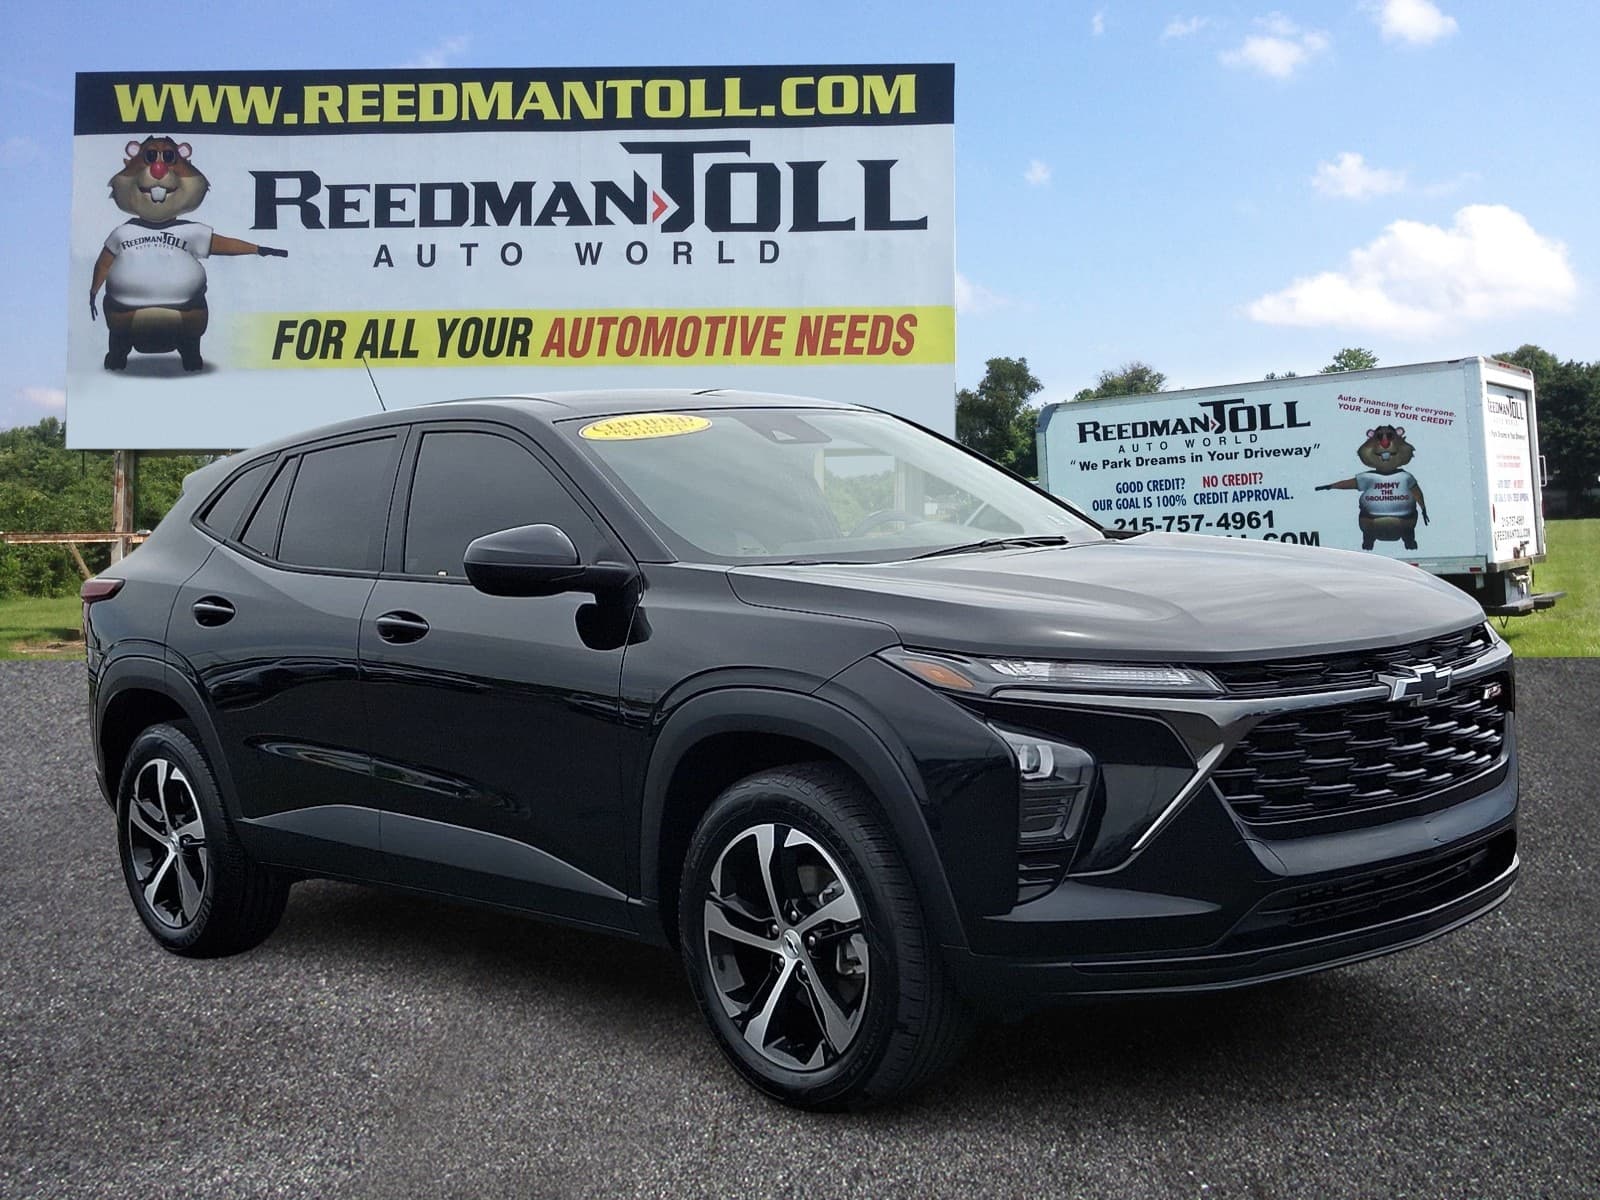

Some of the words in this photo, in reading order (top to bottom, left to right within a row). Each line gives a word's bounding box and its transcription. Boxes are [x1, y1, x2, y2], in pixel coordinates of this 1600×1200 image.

[114, 74, 917, 124] WWW.REEDMANTOLL.COM
[373, 242, 523, 267] AUTO
[575, 240, 780, 266] WORLD
[272, 318, 346, 360] FOR
[355, 318, 419, 360] ALL
[437, 317, 533, 358] YOUR
[541, 315, 786, 358] AUTOMOTIVE
[795, 314, 918, 356] NEEDS
[1338, 394, 1357, 402] Auto
[1358, 397, 1399, 410] Financing
[1338, 403, 1361, 412] YOUR
[1363, 407, 1381, 415] JOB
[1394, 411, 1418, 421] YOUR
[1421, 415, 1454, 426] CREDIT
[1118, 441, 1168, 454] AUTO
[1185, 433, 1258, 449] WORLD
[1102, 459, 1131, 469] Park
[1135, 454, 1186, 467] Dreams
[1191, 452, 1203, 463] in
[1207, 450, 1239, 461] Your
[1115, 480, 1144, 494] GOOD
[1147, 478, 1185, 492] CREDIT?
[1202, 475, 1218, 488] NO
[1222, 472, 1263, 487] CREDIT?
[1092, 499, 1112, 511] OUR
[1115, 497, 1141, 510] GOAL
[1143, 496, 1153, 508] IS
[1156, 494, 1187, 508] 100%
[1193, 492, 1229, 506] CREDIT
[1232, 487, 1294, 504] APPROVAL.
[1114, 510, 1274, 533] 215-757-4961
